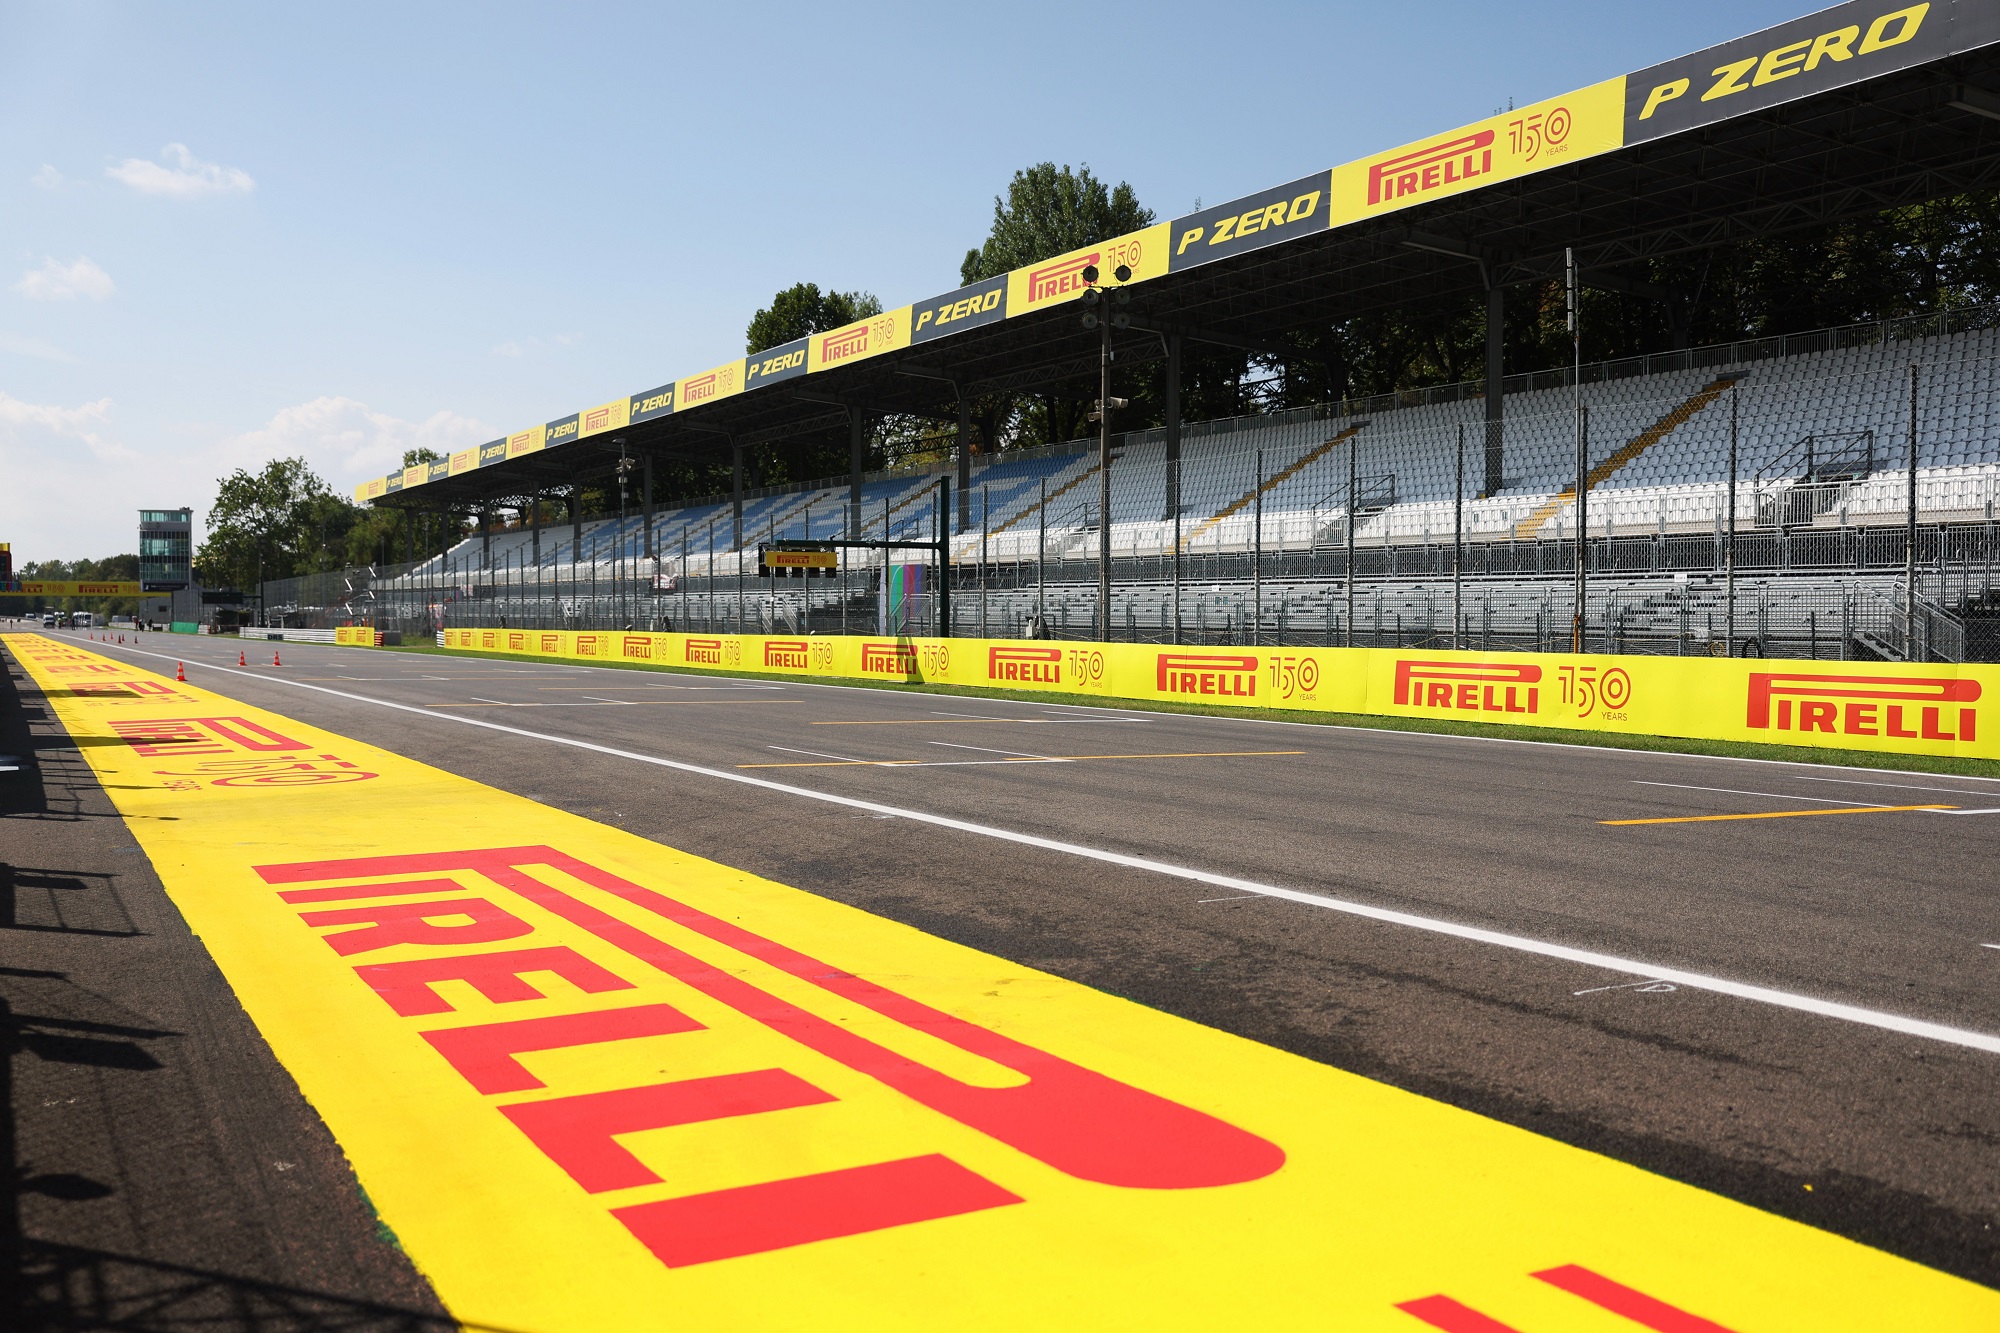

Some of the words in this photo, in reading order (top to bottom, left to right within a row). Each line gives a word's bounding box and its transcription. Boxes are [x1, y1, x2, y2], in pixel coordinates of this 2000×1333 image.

[1639, 78, 1690, 120] P
[1701, 2, 1930, 102] ZERO
[1367, 129, 1495, 206] PIRELLI
[1509, 107, 1571, 162] 150
[1546, 144, 1568, 157] YEARS
[1177, 227, 1204, 255] P
[1209, 190, 1321, 246] ZERO
[915, 310, 933, 331] P
[935, 288, 1002, 326] ZERO
[822, 326, 869, 363] PIRELLI
[873, 317, 894, 347] 150
[748, 364, 759, 380] P
[761, 349, 805, 377] ZERO
[684, 374, 716, 403] PIRELLI
[631, 402, 640, 416] P
[641, 391, 672, 413] ZERO
[546, 429, 553, 441] P
[553, 420, 577, 438] ZERO
[586, 408, 609, 431] PIRELLI
[481, 451, 486, 460] P
[486, 443, 505, 459] ZERO
[777, 555, 809, 564] PIRELLI
[79, 585, 118, 593] PIRELLI
[576, 636, 597, 655] PIRELLI
[623, 636, 651, 659] PIRELLI
[686, 639, 721, 664] PIRELLI
[764, 641, 808, 669] PIRELLI
[812, 642, 833, 670] 150
[862, 643, 918, 675] PIRELLI
[923, 645, 949, 676] 150
[989, 646, 1062, 684] PIRELLI
[1069, 650, 1104, 687] 150
[1156, 654, 1258, 697] PIRELLI
[1269, 656, 1319, 700] 150
[1299, 693, 1317, 701] YEARS
[1394, 660, 1542, 714] PIRELLI
[1558, 666, 1631, 718] 150
[1601, 711, 1628, 721] YEARS
[1746, 673, 1982, 742] PIRELLI
[253, 845, 1286, 1269] PIRELLI
